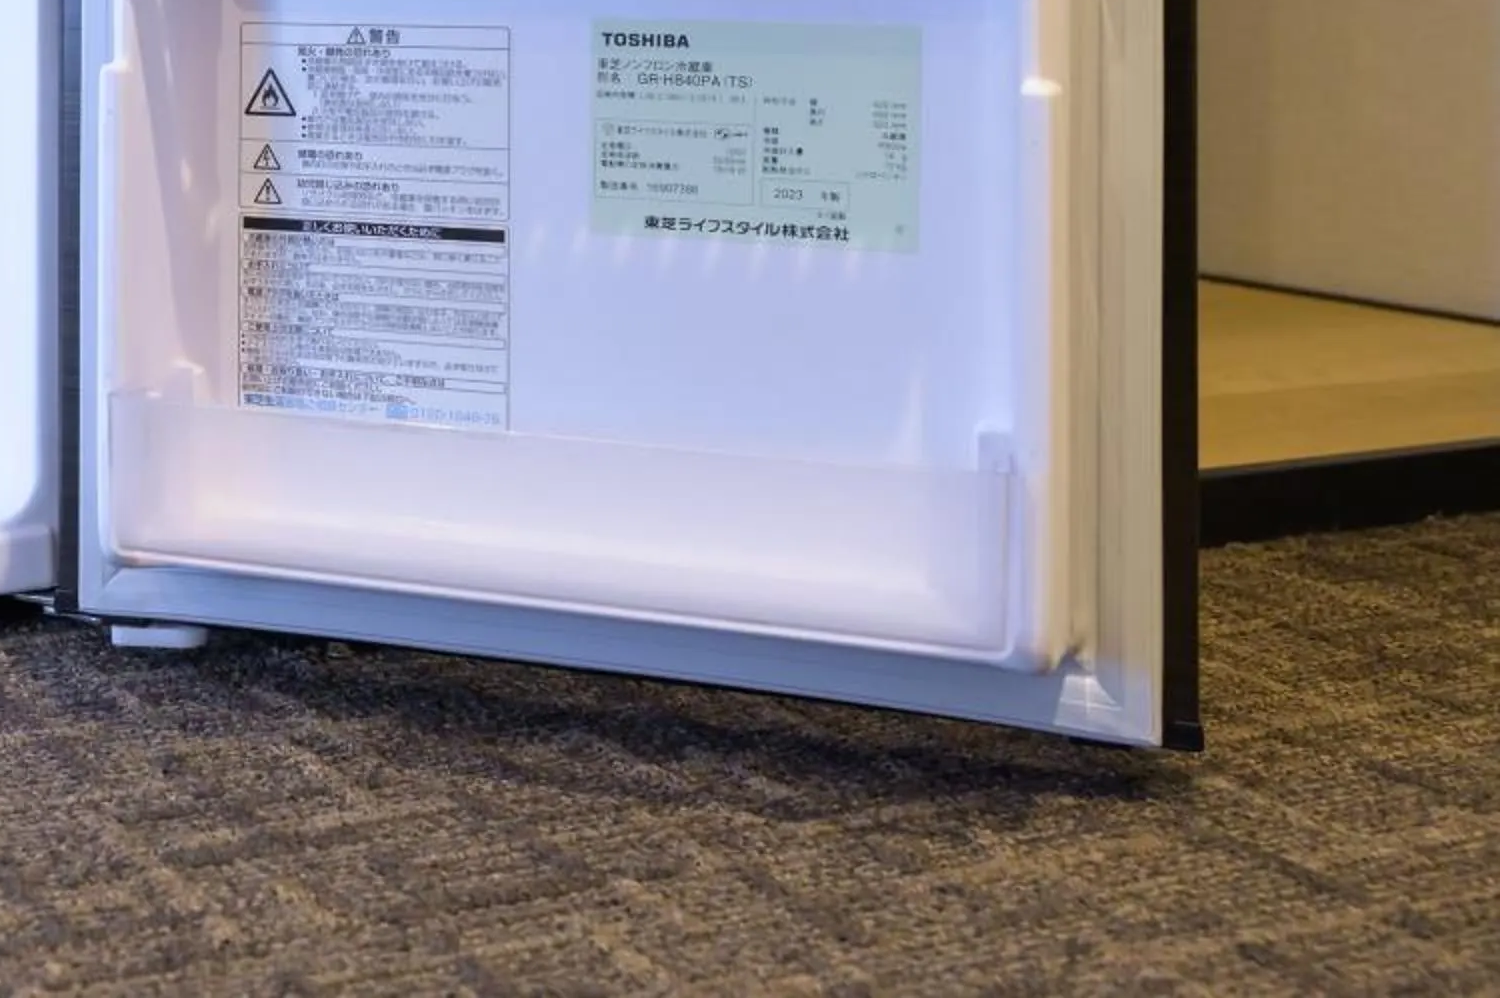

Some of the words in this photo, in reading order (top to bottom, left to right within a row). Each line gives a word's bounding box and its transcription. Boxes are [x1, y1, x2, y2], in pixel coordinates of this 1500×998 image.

[369, 29, 400, 44] 警告
[602, 32, 690, 48] TOSHIBA
[773, 188, 804, 201] 2023
[644, 214, 850, 241] 東芝ライフスタイル株式会社
